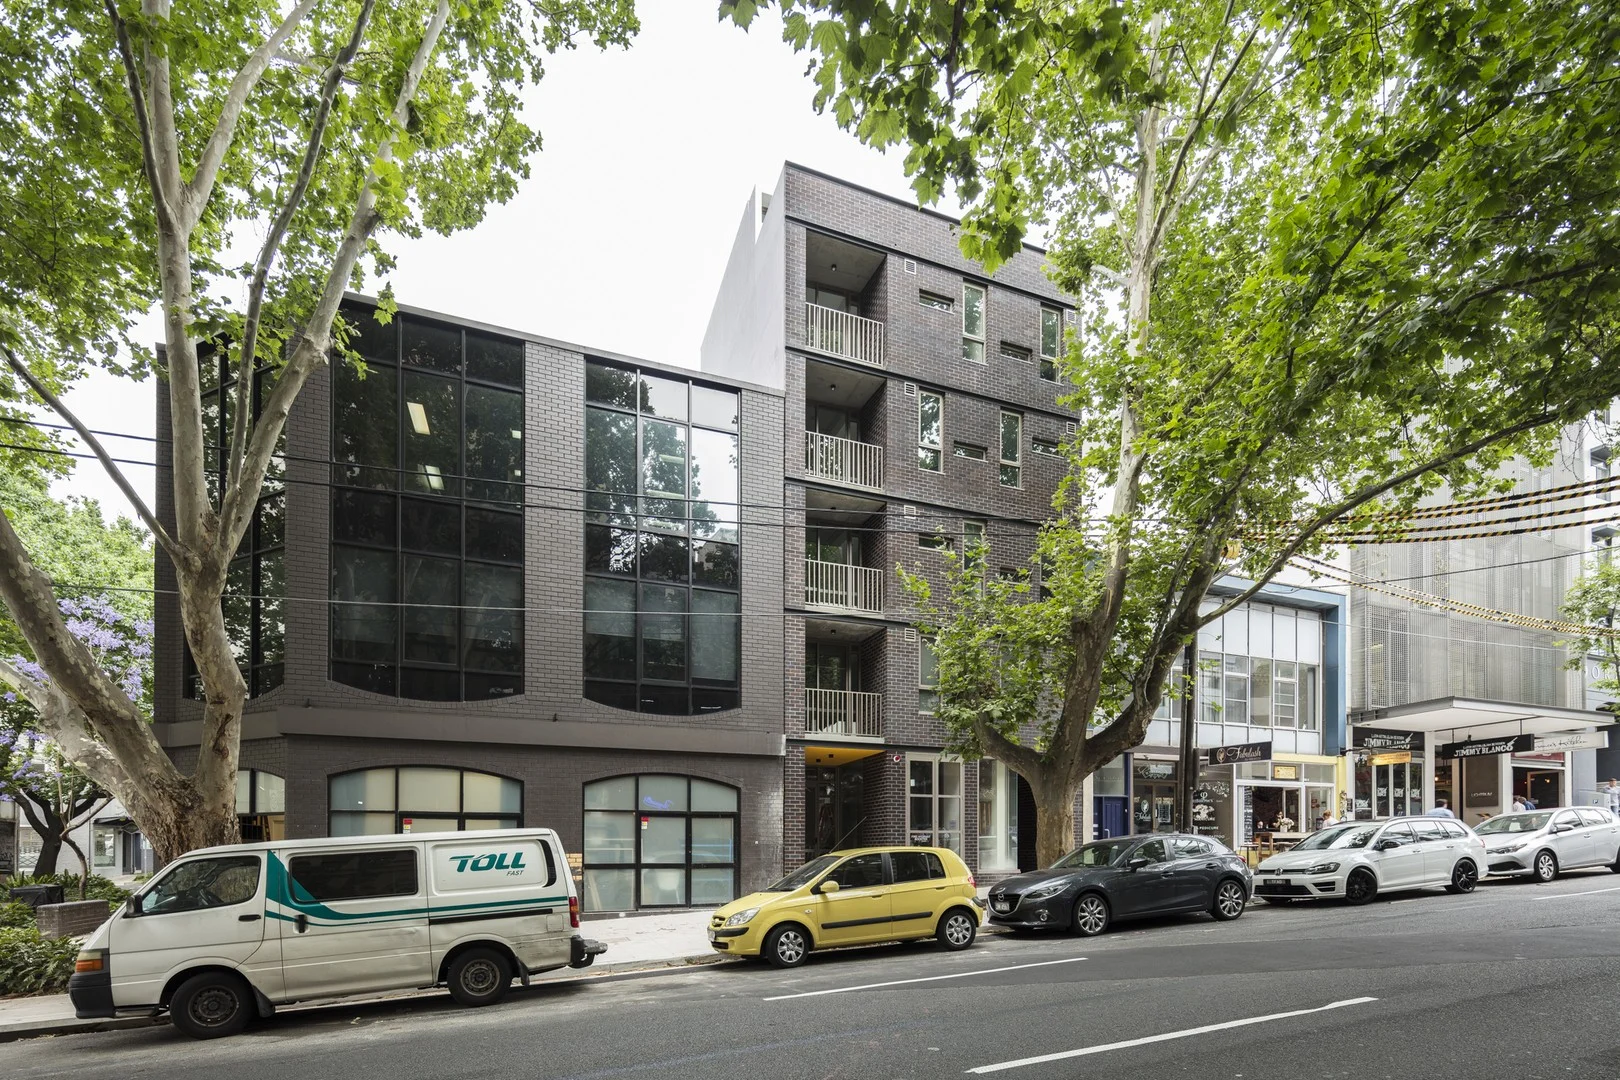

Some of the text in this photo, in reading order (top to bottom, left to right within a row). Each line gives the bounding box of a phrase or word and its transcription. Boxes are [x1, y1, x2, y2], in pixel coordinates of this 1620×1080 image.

[1363, 737, 1386, 748] JIMMY
[1453, 747, 1481, 757] JIMMY
[1481, 744, 1514, 755] BLANCO
[449, 852, 526, 873] TOLL
